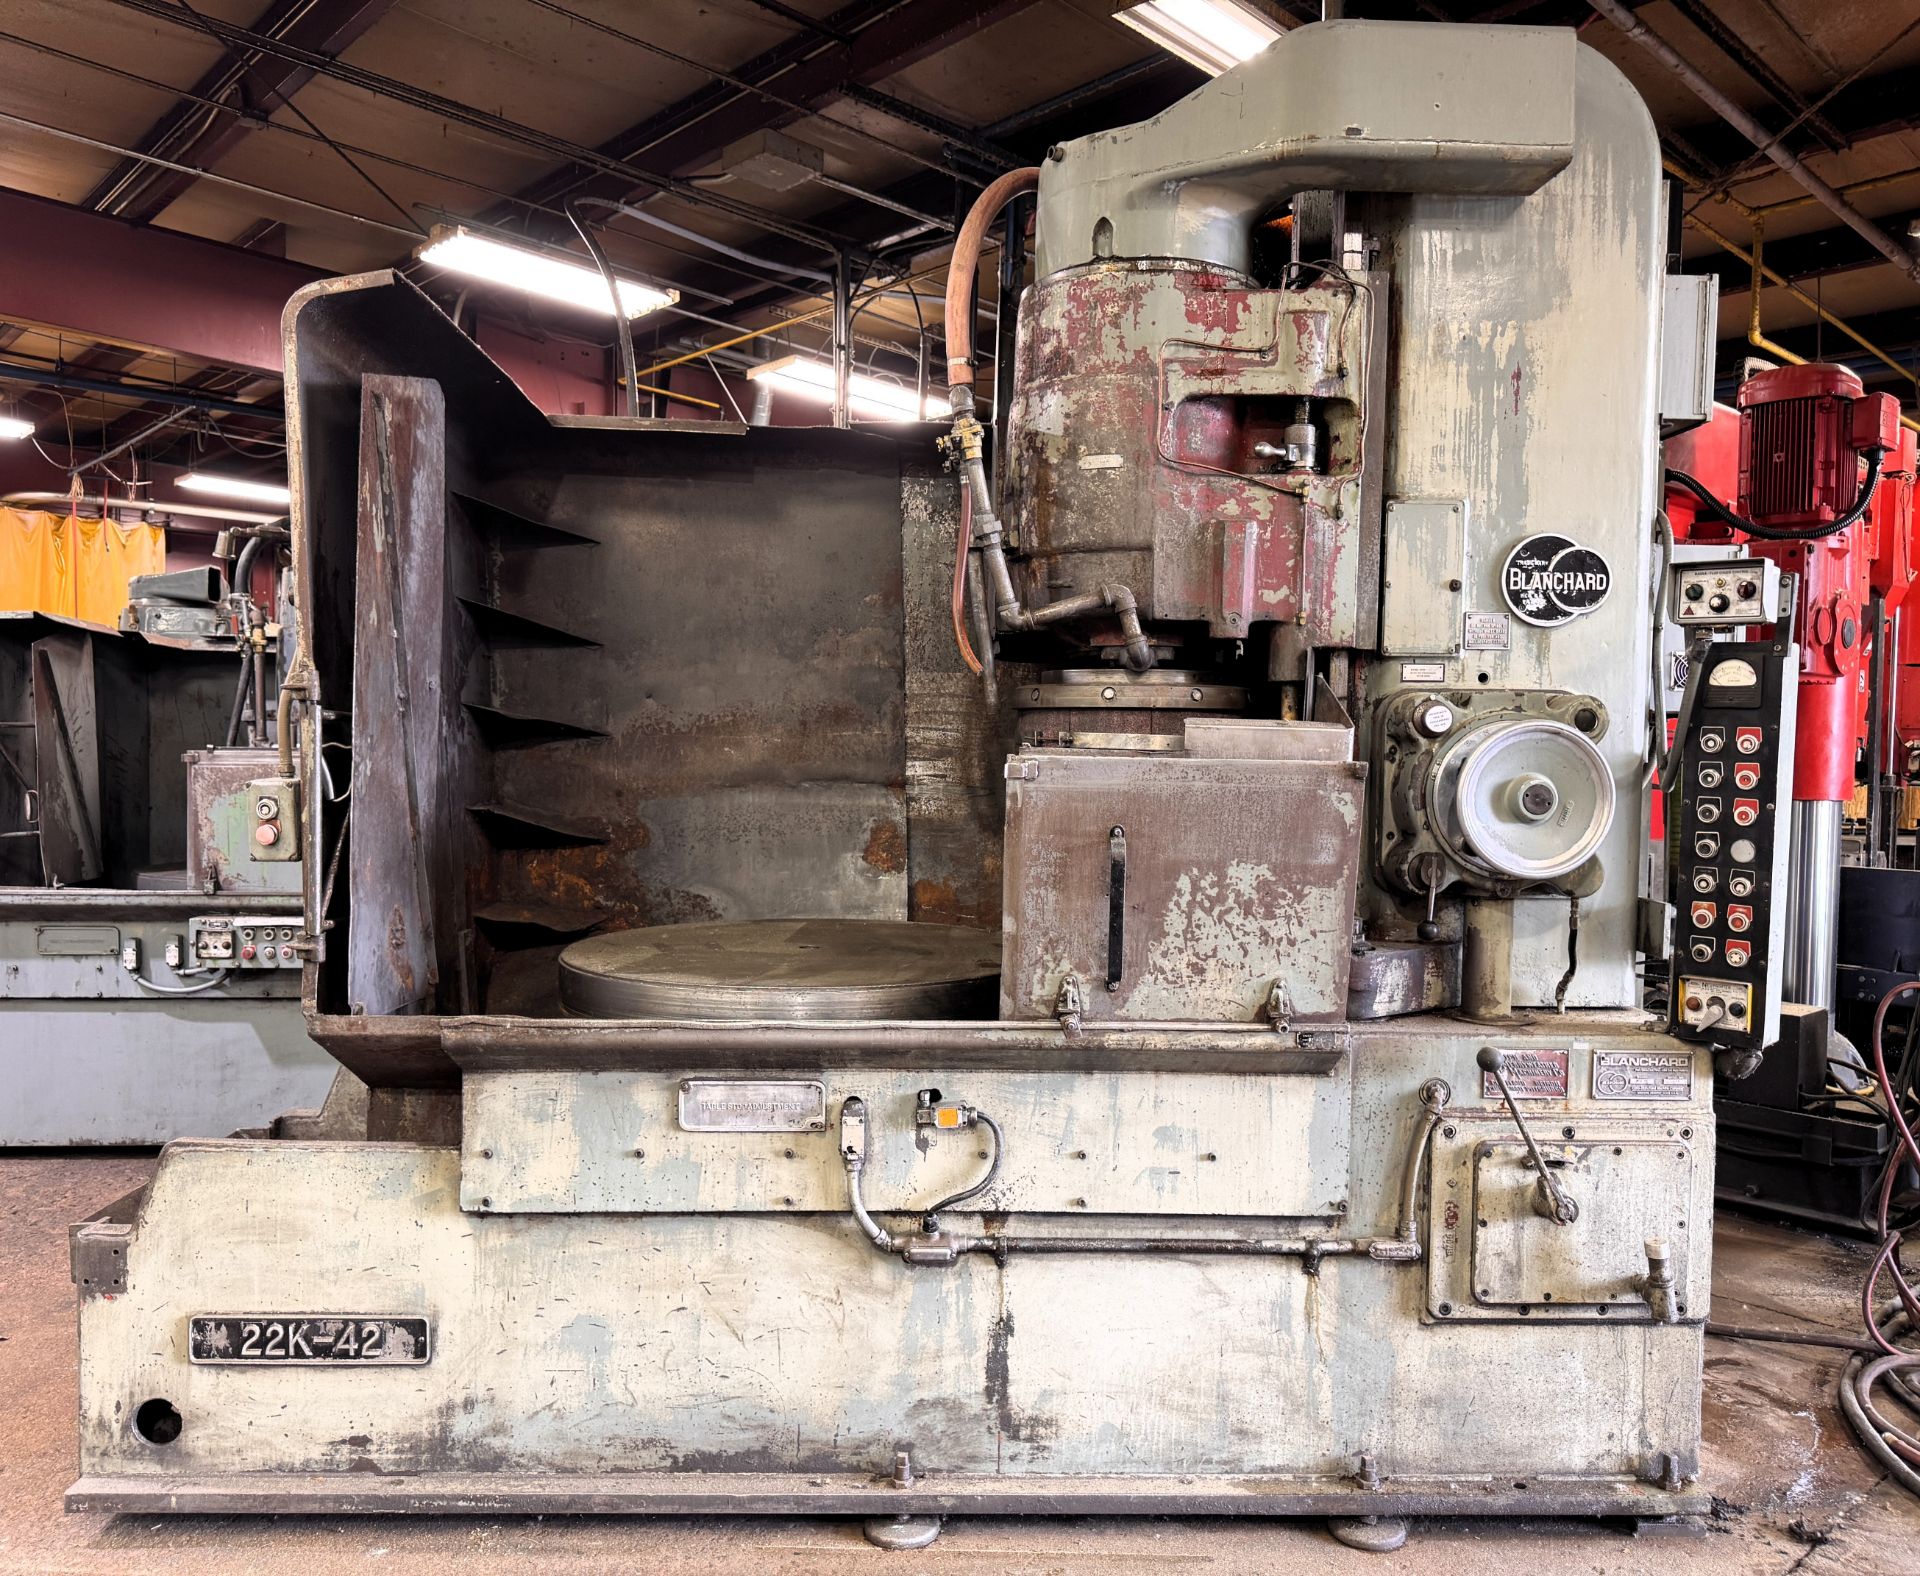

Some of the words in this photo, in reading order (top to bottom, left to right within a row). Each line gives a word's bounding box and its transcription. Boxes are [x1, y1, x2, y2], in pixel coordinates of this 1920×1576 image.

[1509, 568, 1607, 591] BLANCHARD
[1600, 1056, 1688, 1067] BLANCHARD
[701, 1102, 726, 1110] TABLE
[241, 1322, 383, 1356] 22K-42
